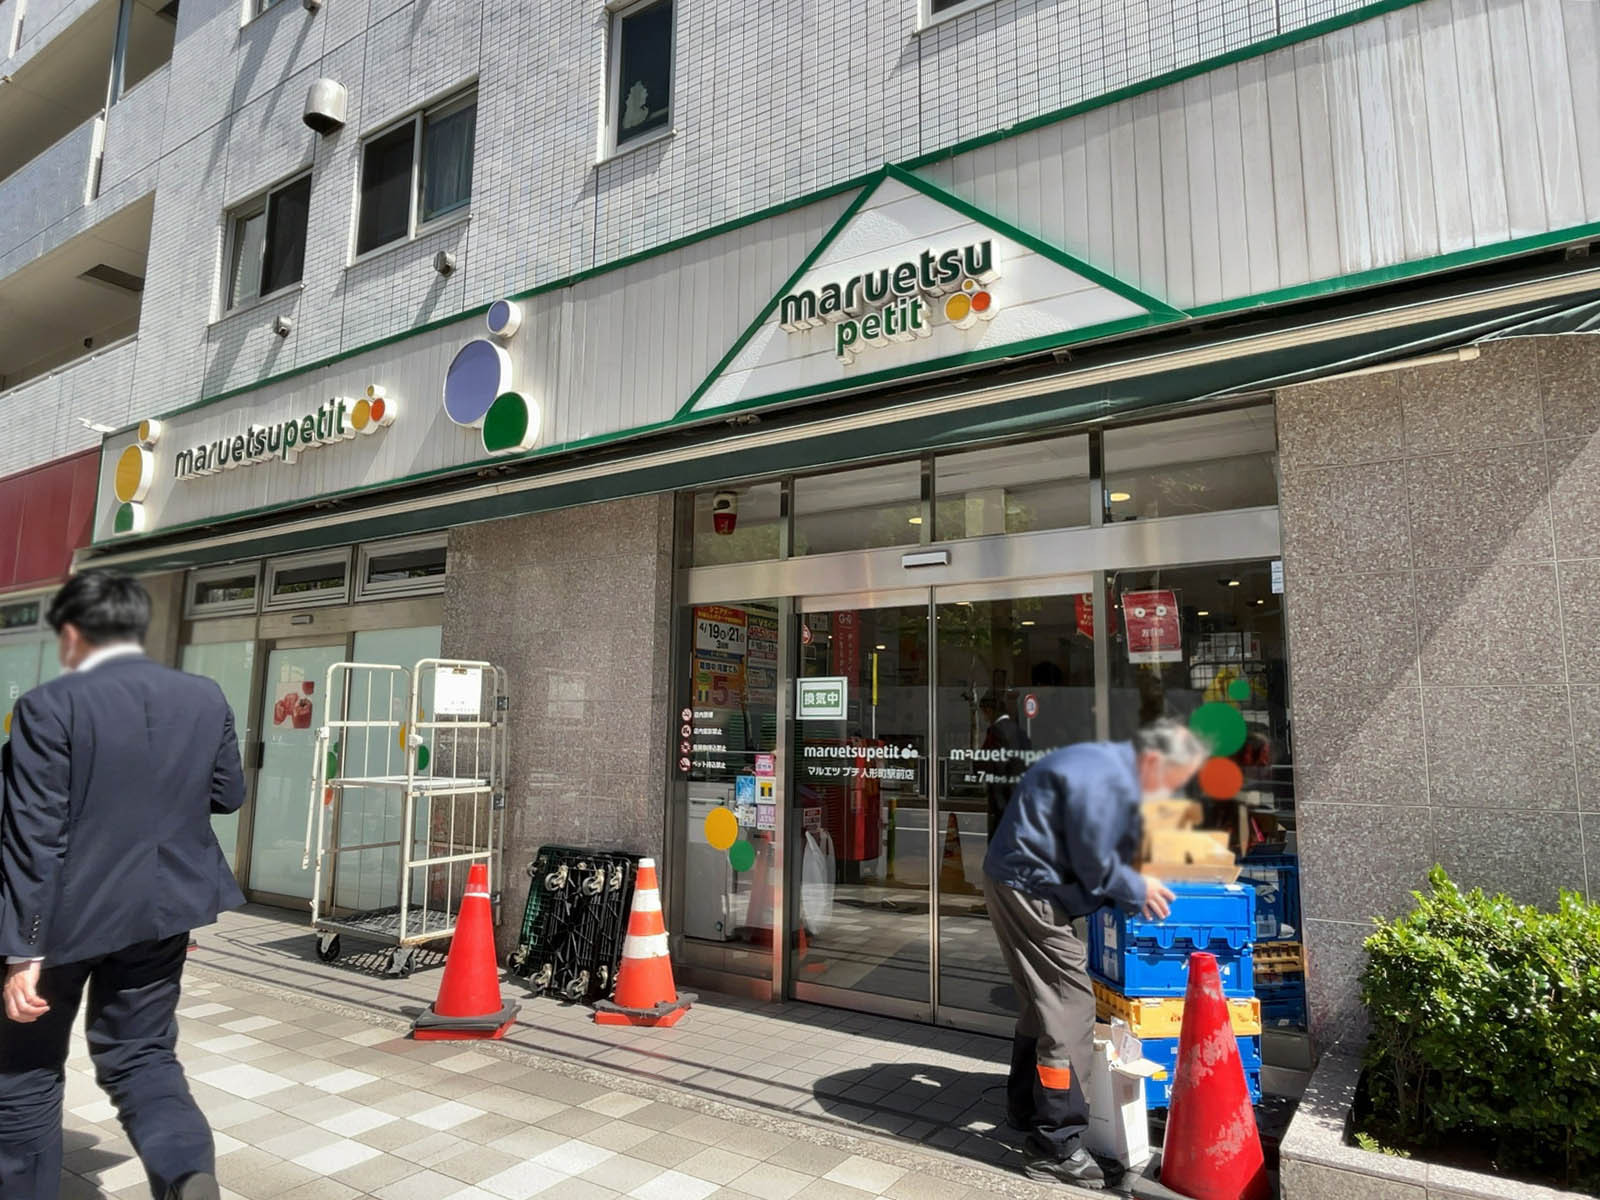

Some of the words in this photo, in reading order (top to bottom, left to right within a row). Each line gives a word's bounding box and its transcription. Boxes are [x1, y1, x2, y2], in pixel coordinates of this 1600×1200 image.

[780, 239, 993, 325] maruetsu
[835, 296, 923, 358] petit
[174, 398, 347, 479] maruetsupetit
[804, 691, 838, 705] 換気中
[804, 744, 900, 762] maruetsupetit
